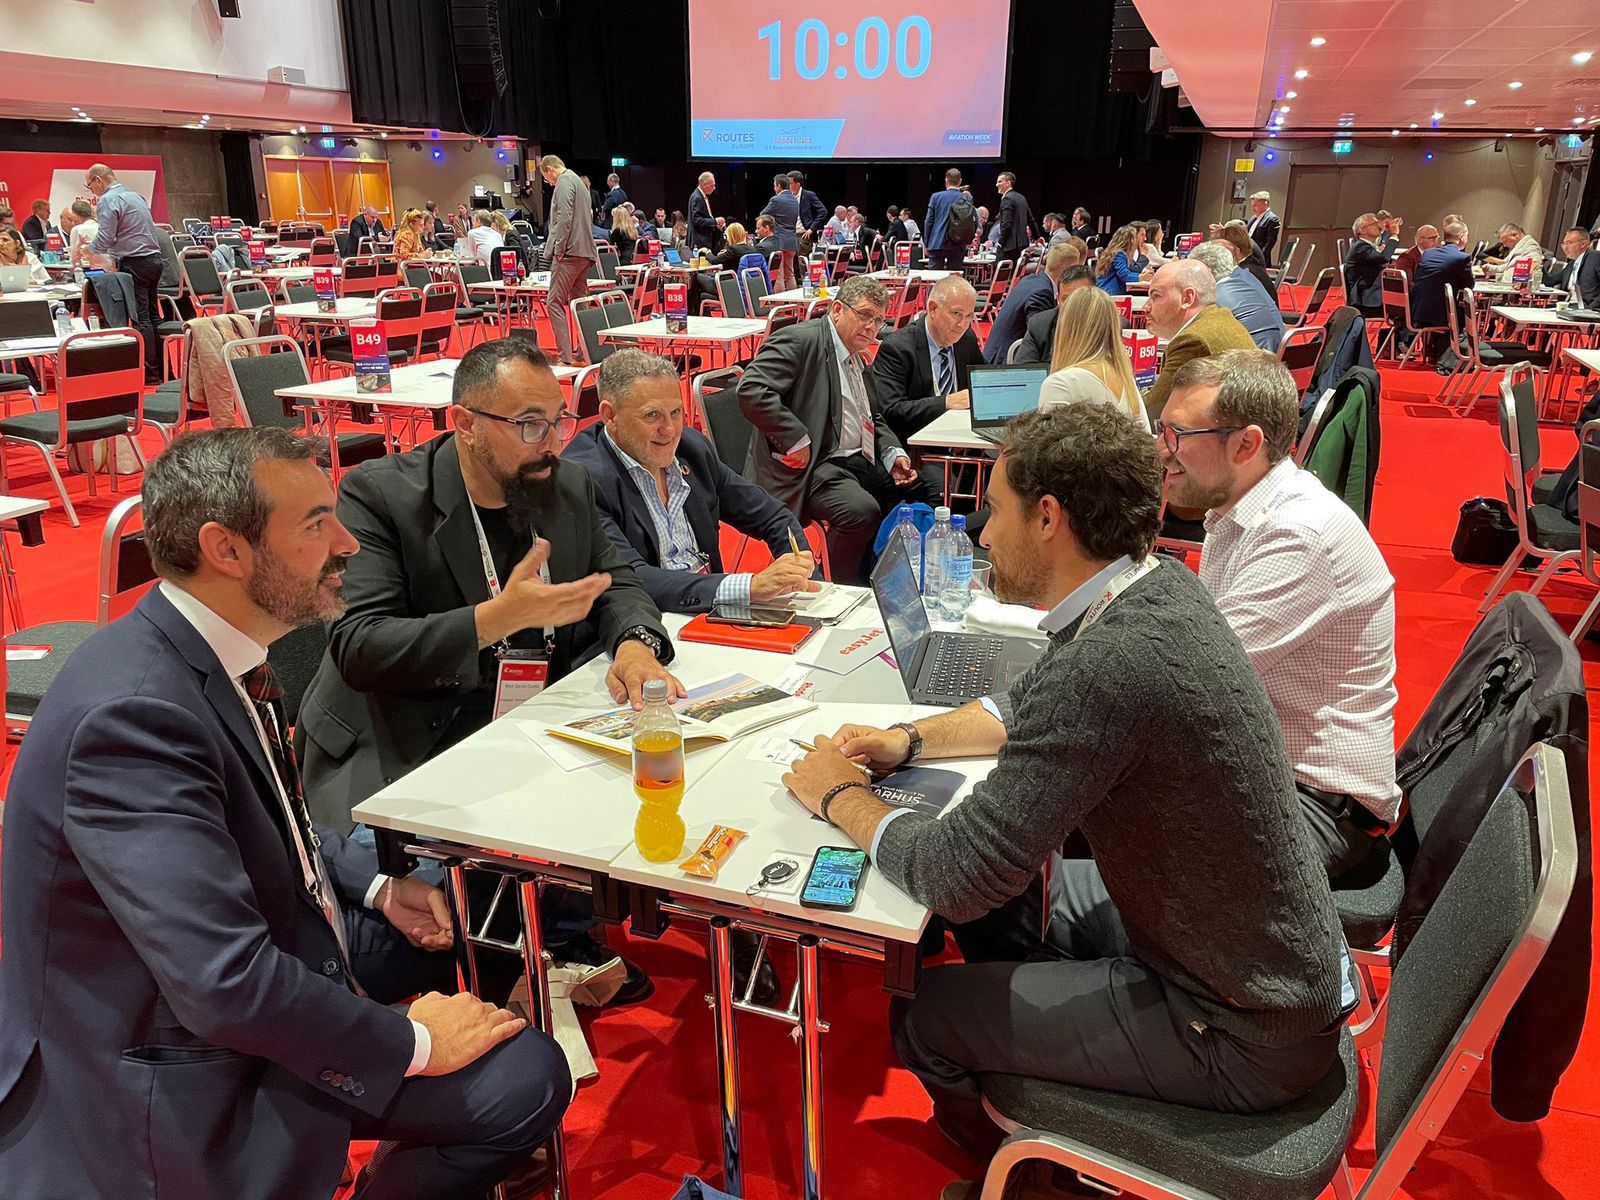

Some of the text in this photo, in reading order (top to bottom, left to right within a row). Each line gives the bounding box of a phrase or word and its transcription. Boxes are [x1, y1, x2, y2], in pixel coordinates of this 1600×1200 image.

[757, 15, 933, 81] 10:00
[716, 133, 755, 142] ROUTES
[316, 276, 330, 284] B39
[667, 294, 683, 302] B38
[355, 333, 382, 346] B49
[1140, 345, 1156, 358] B50
[1086, 599, 1106, 624] ROUTES
[839, 628, 885, 656] easyJet
